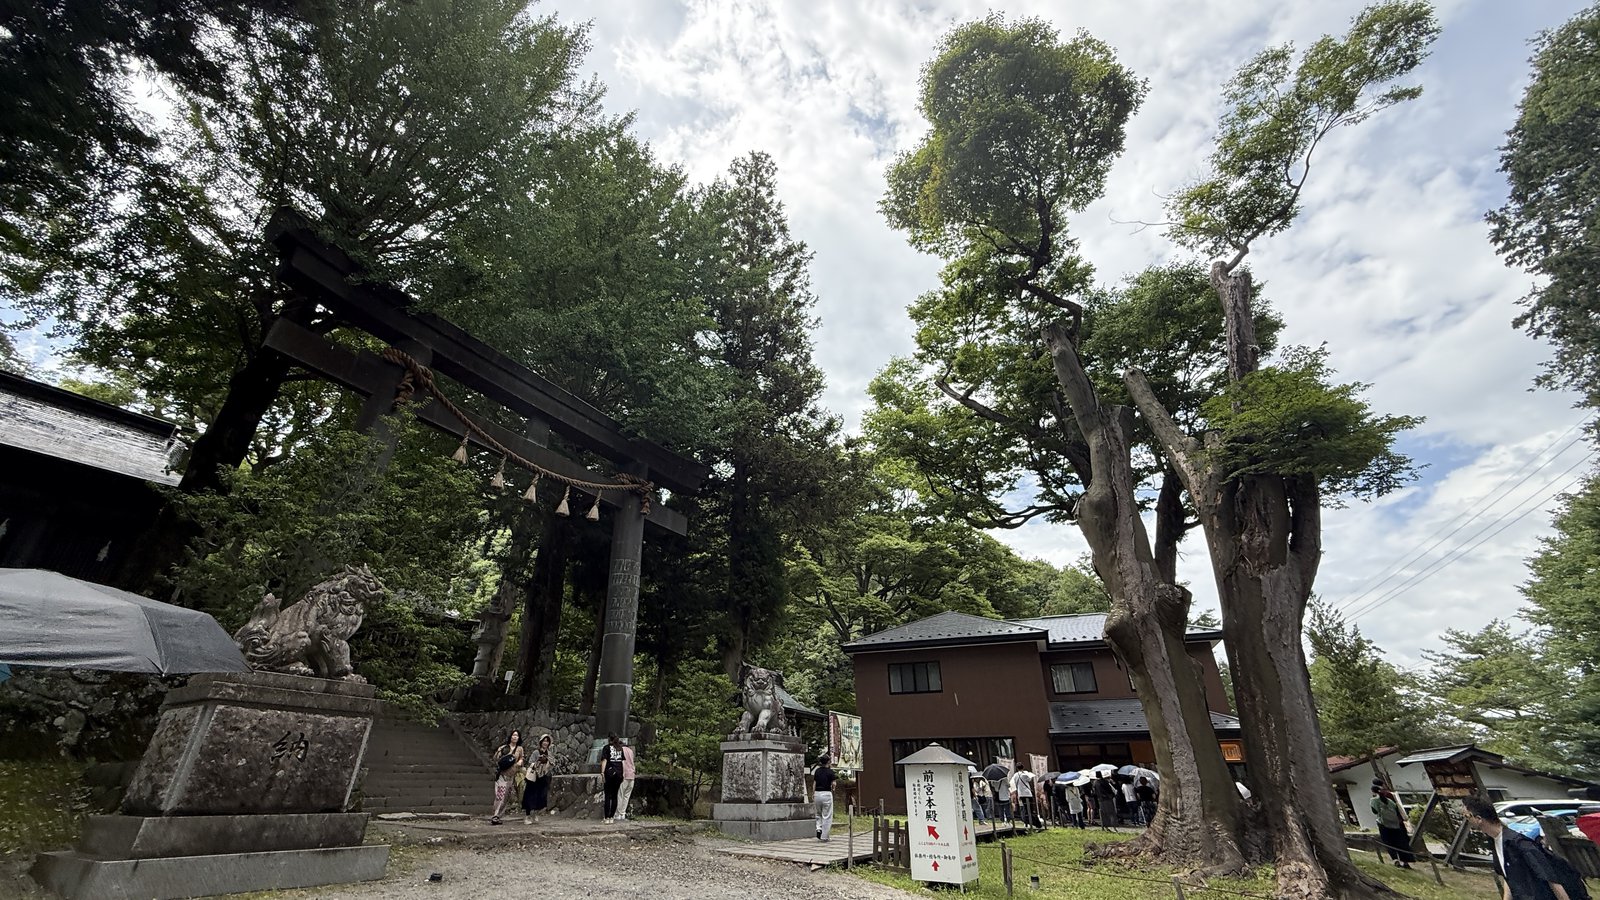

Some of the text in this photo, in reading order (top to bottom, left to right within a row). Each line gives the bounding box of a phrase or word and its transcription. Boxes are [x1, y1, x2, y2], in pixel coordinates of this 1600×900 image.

[270, 731, 309, 763] 納
[922, 769, 938, 822] 前宮本殿
